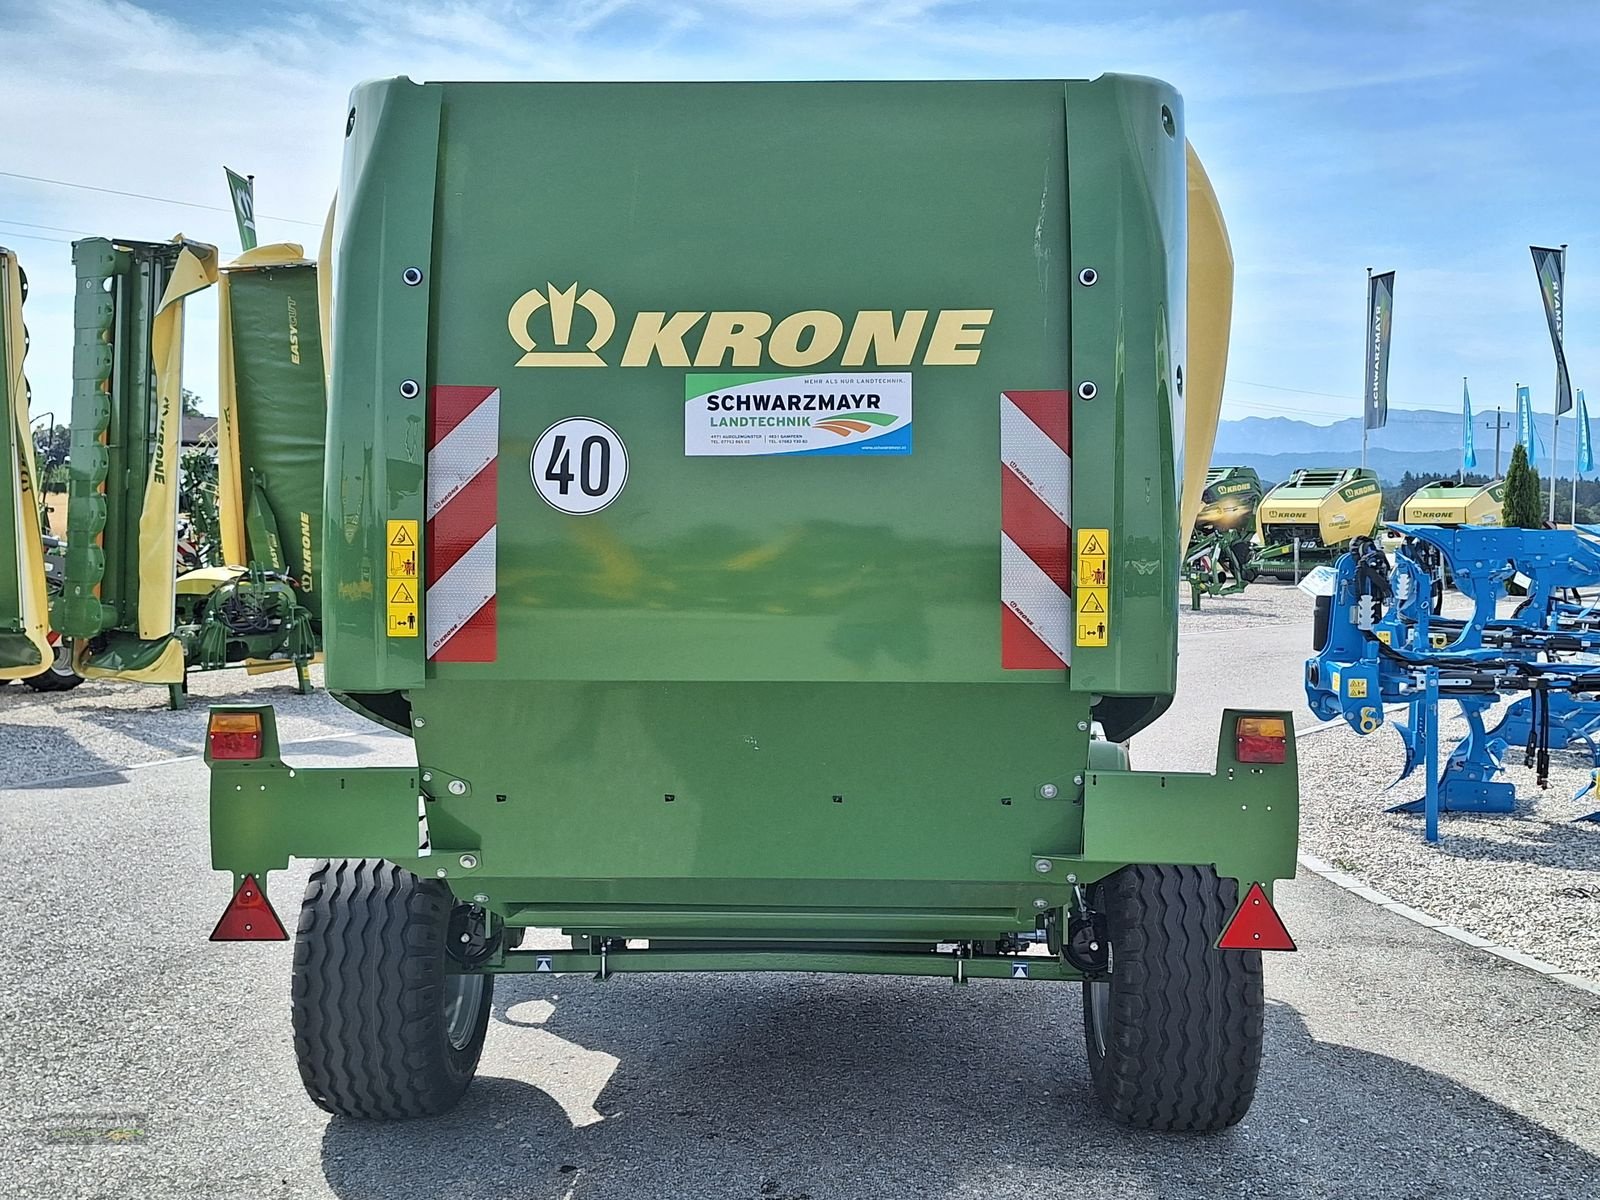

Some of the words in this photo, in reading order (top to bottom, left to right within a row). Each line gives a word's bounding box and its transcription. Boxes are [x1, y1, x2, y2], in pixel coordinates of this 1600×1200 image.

[621, 309, 994, 368] KRONE
[1373, 305, 1381, 409] SCHWARZMAYR
[706, 394, 881, 411] SCHWARZMAYR
[710, 416, 811, 427] LANDTECHNIK
[544, 435, 611, 497] 40
[1015, 468, 1034, 486] KRONE
[440, 485, 459, 504] KRONE
[1227, 483, 1251, 493] KRONE
[1354, 484, 1376, 496] KRONE
[300, 511, 312, 574] KRONE
[1015, 607, 1034, 625] KRONE
[440, 623, 458, 642] KRONE
